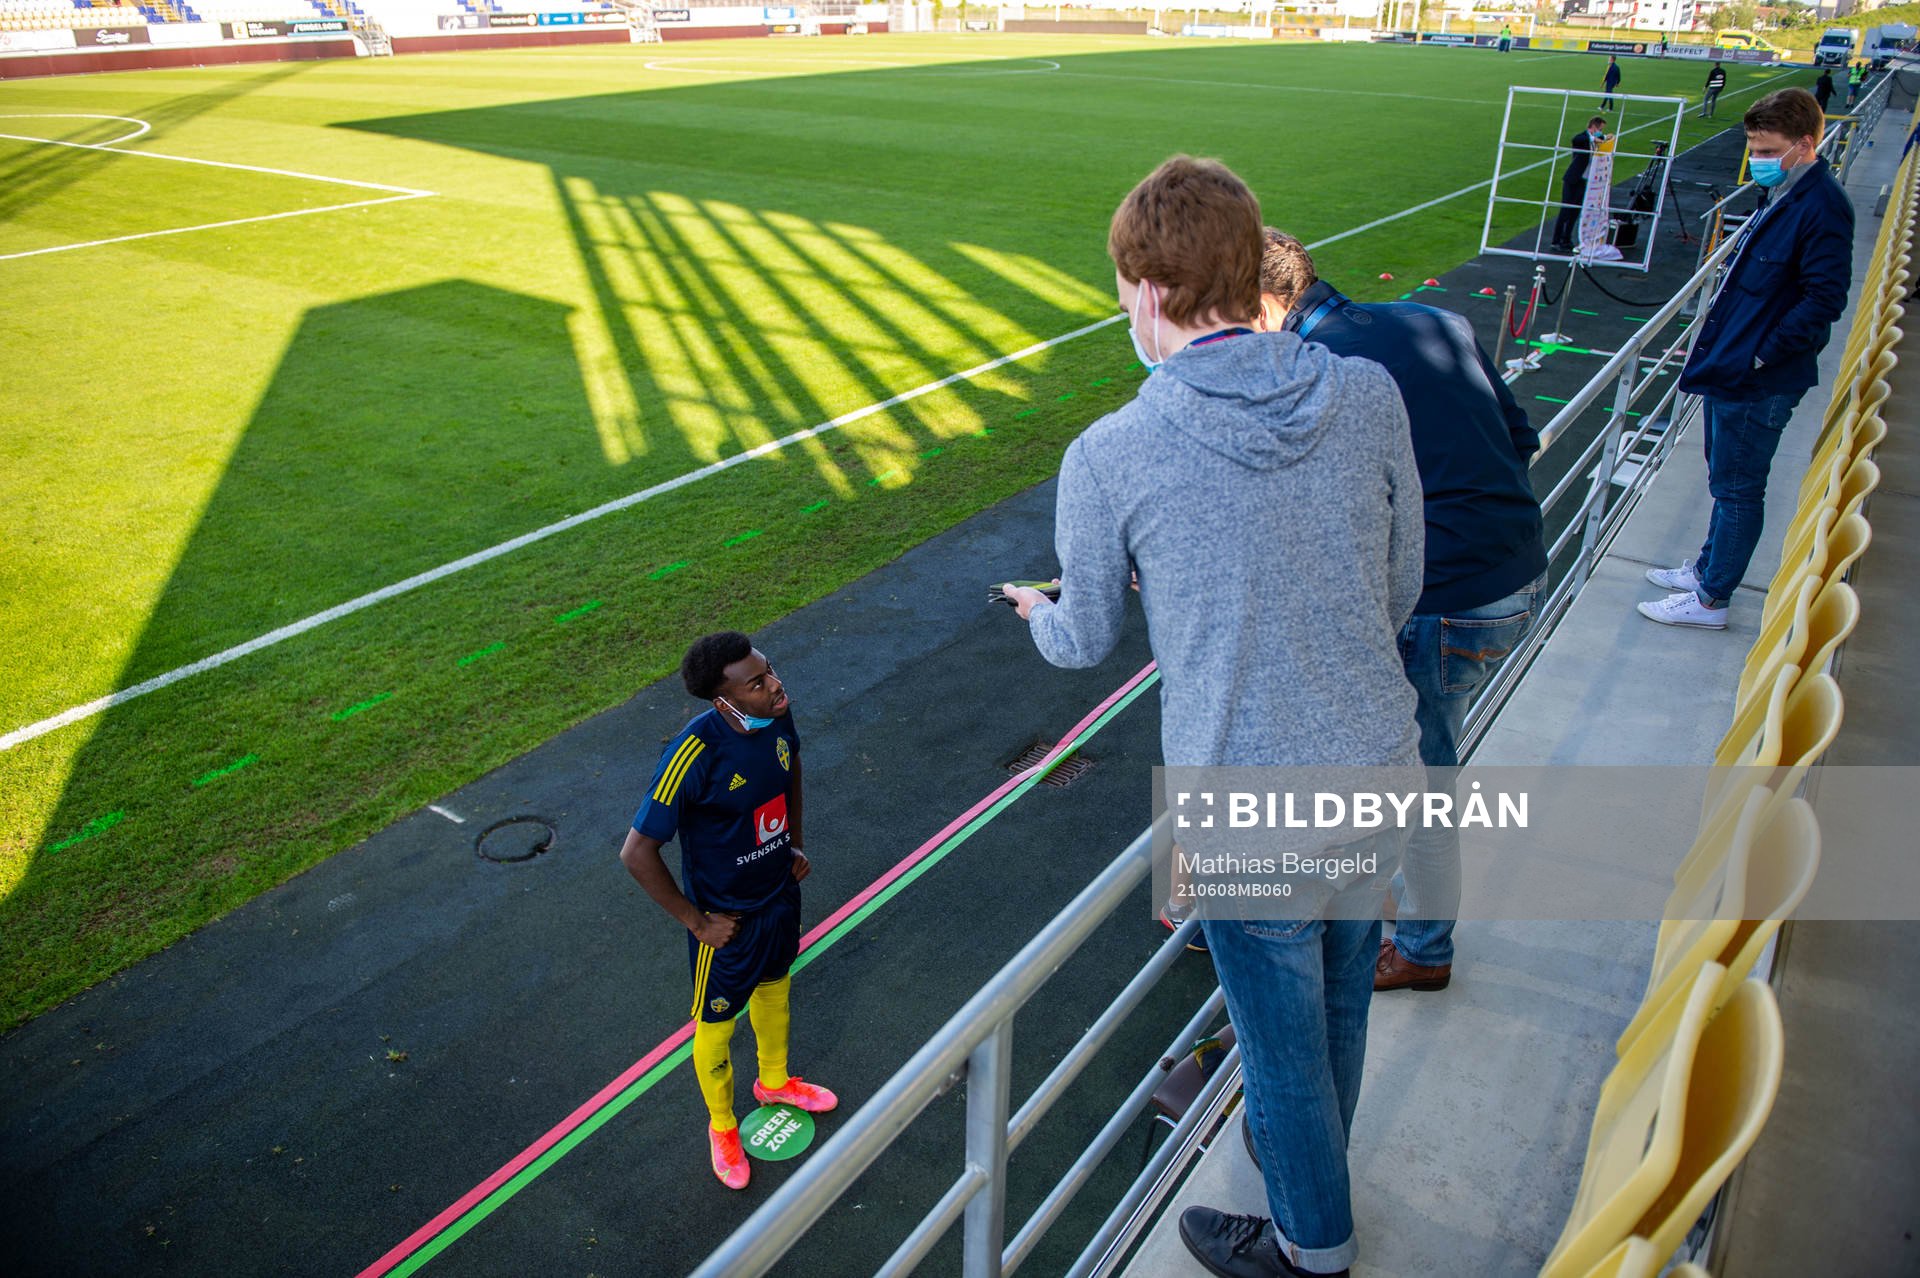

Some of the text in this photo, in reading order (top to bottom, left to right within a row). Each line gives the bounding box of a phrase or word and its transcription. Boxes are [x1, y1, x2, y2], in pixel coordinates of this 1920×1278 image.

[736, 838, 783, 866] SVENSKA
[750, 1108, 792, 1146] GREEN
[765, 1118, 803, 1153] ZONE
